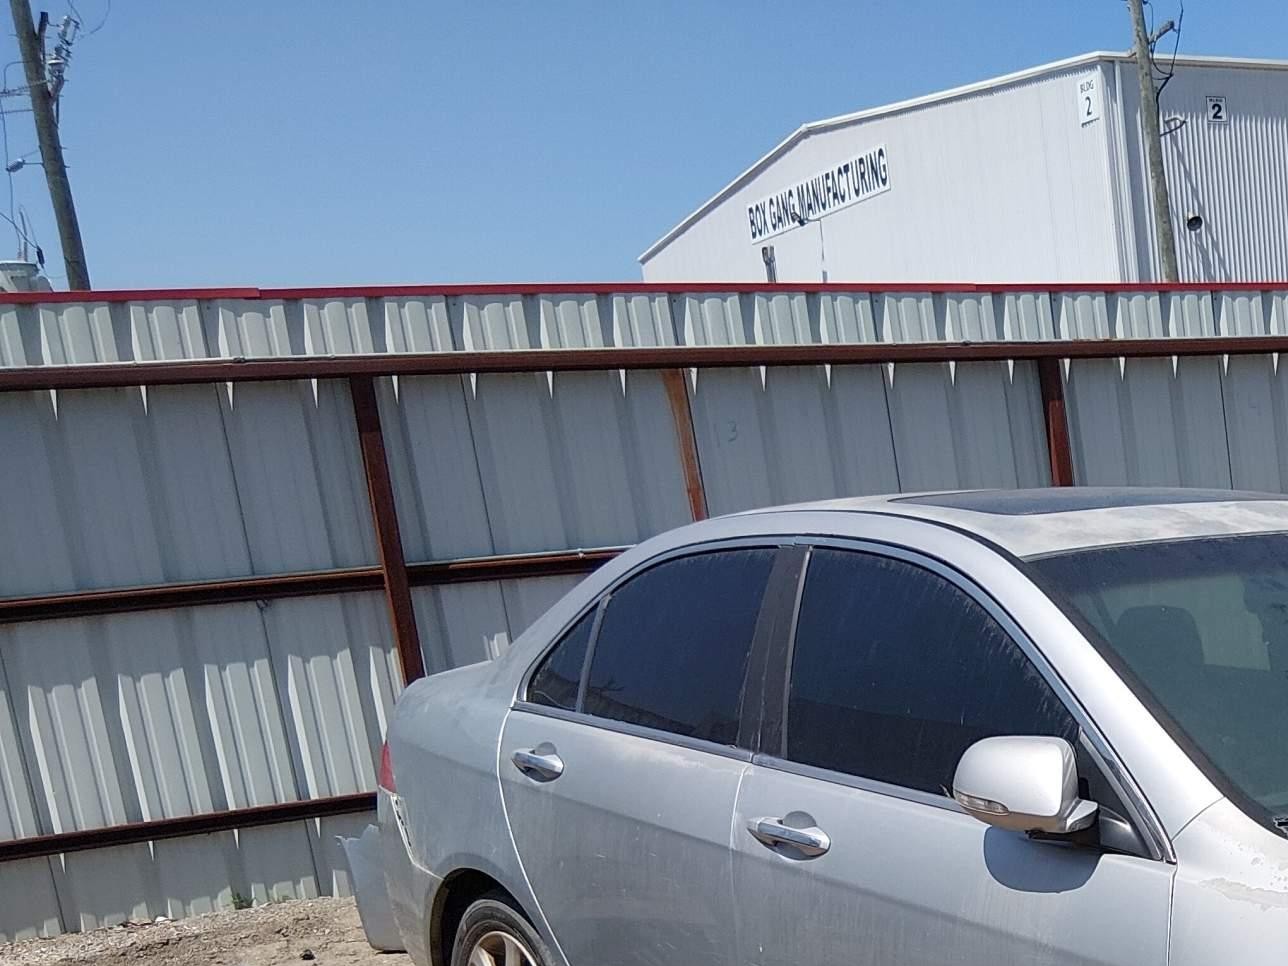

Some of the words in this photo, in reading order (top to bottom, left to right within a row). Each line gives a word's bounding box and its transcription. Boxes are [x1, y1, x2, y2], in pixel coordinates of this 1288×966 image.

[1085, 97, 1092, 116] 2
[1211, 103, 1223, 119] 2
[748, 202, 769, 239] BOX
[769, 189, 796, 232] GANG
[797, 148, 888, 221] MANUFACTURING
